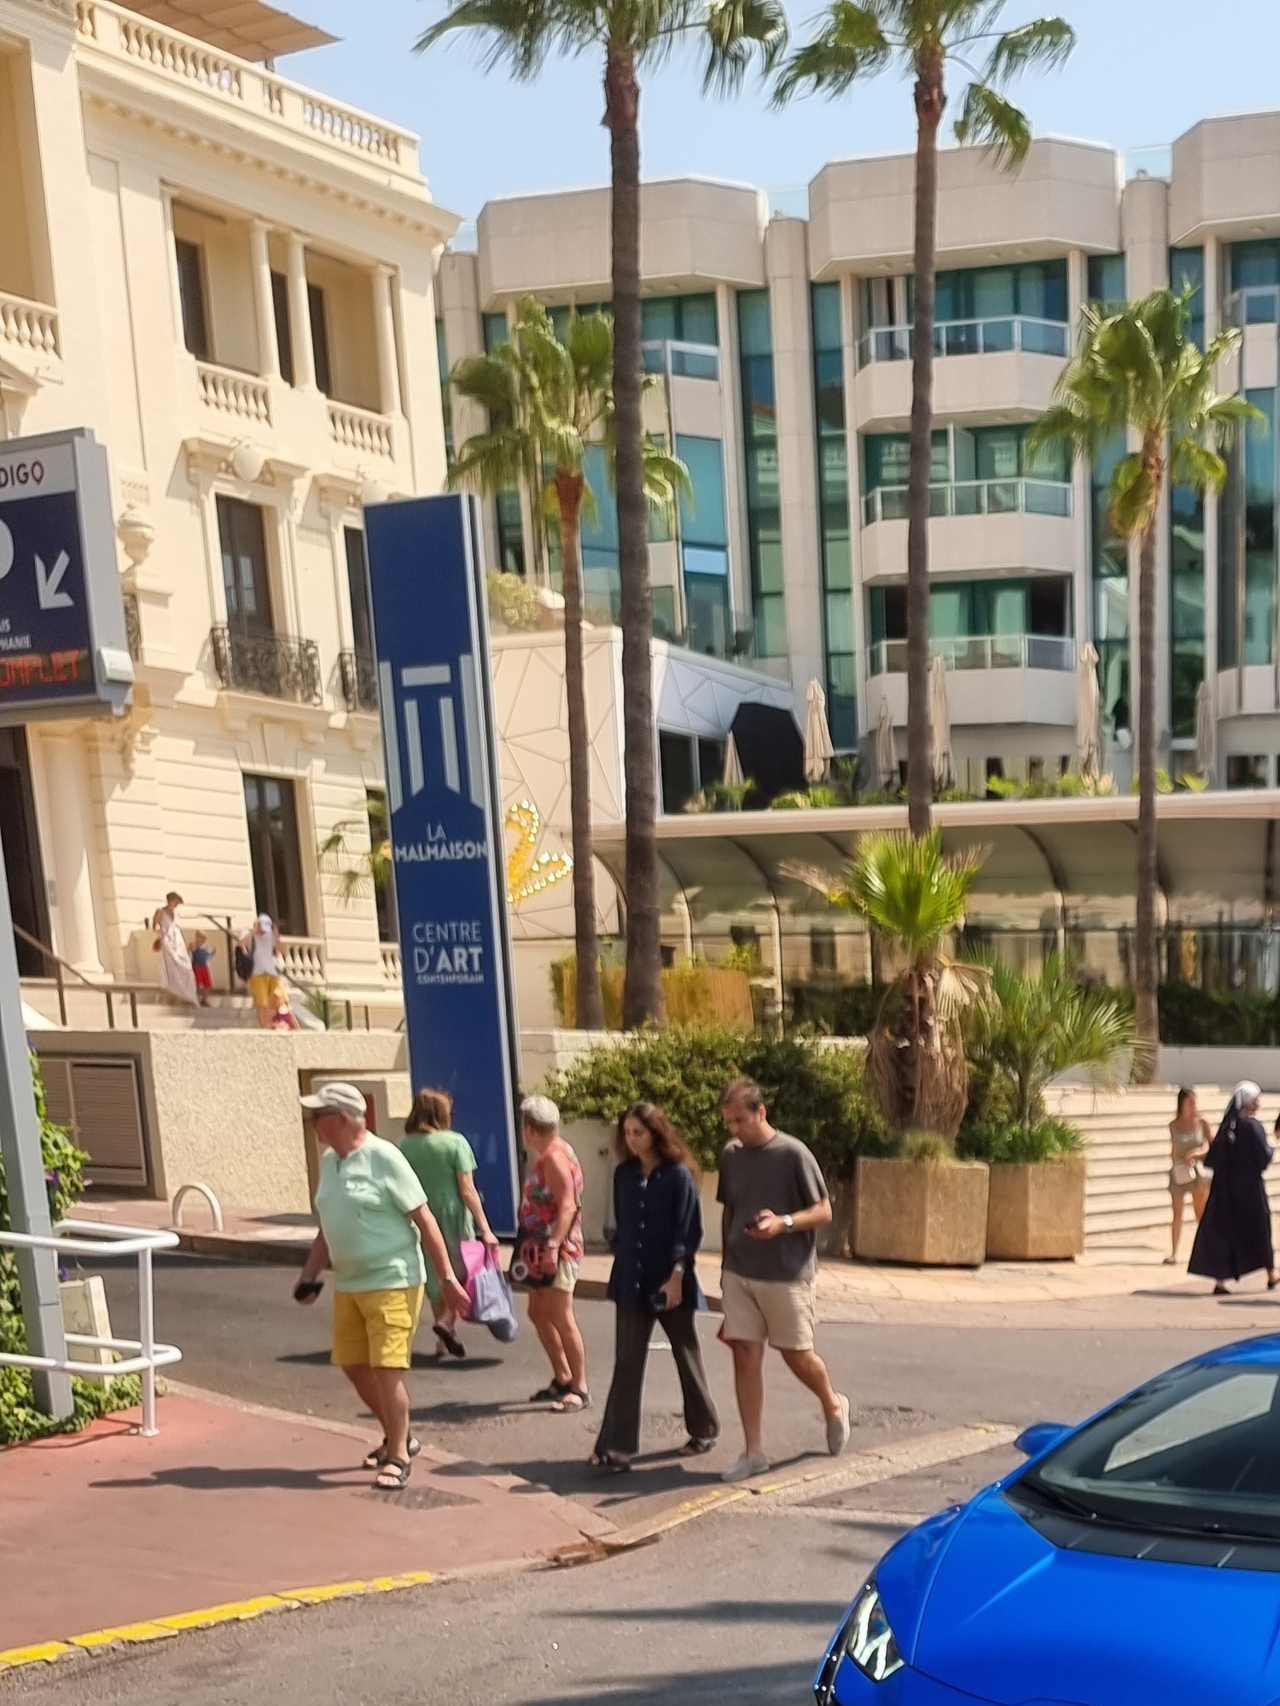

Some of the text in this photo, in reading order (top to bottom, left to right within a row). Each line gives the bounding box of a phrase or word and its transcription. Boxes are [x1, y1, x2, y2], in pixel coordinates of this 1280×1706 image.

[427, 822, 447, 841] LA
[395, 840, 488, 863] MALMAISON
[412, 921, 482, 943] CENTRE
[413, 945, 484, 974] D'ART
